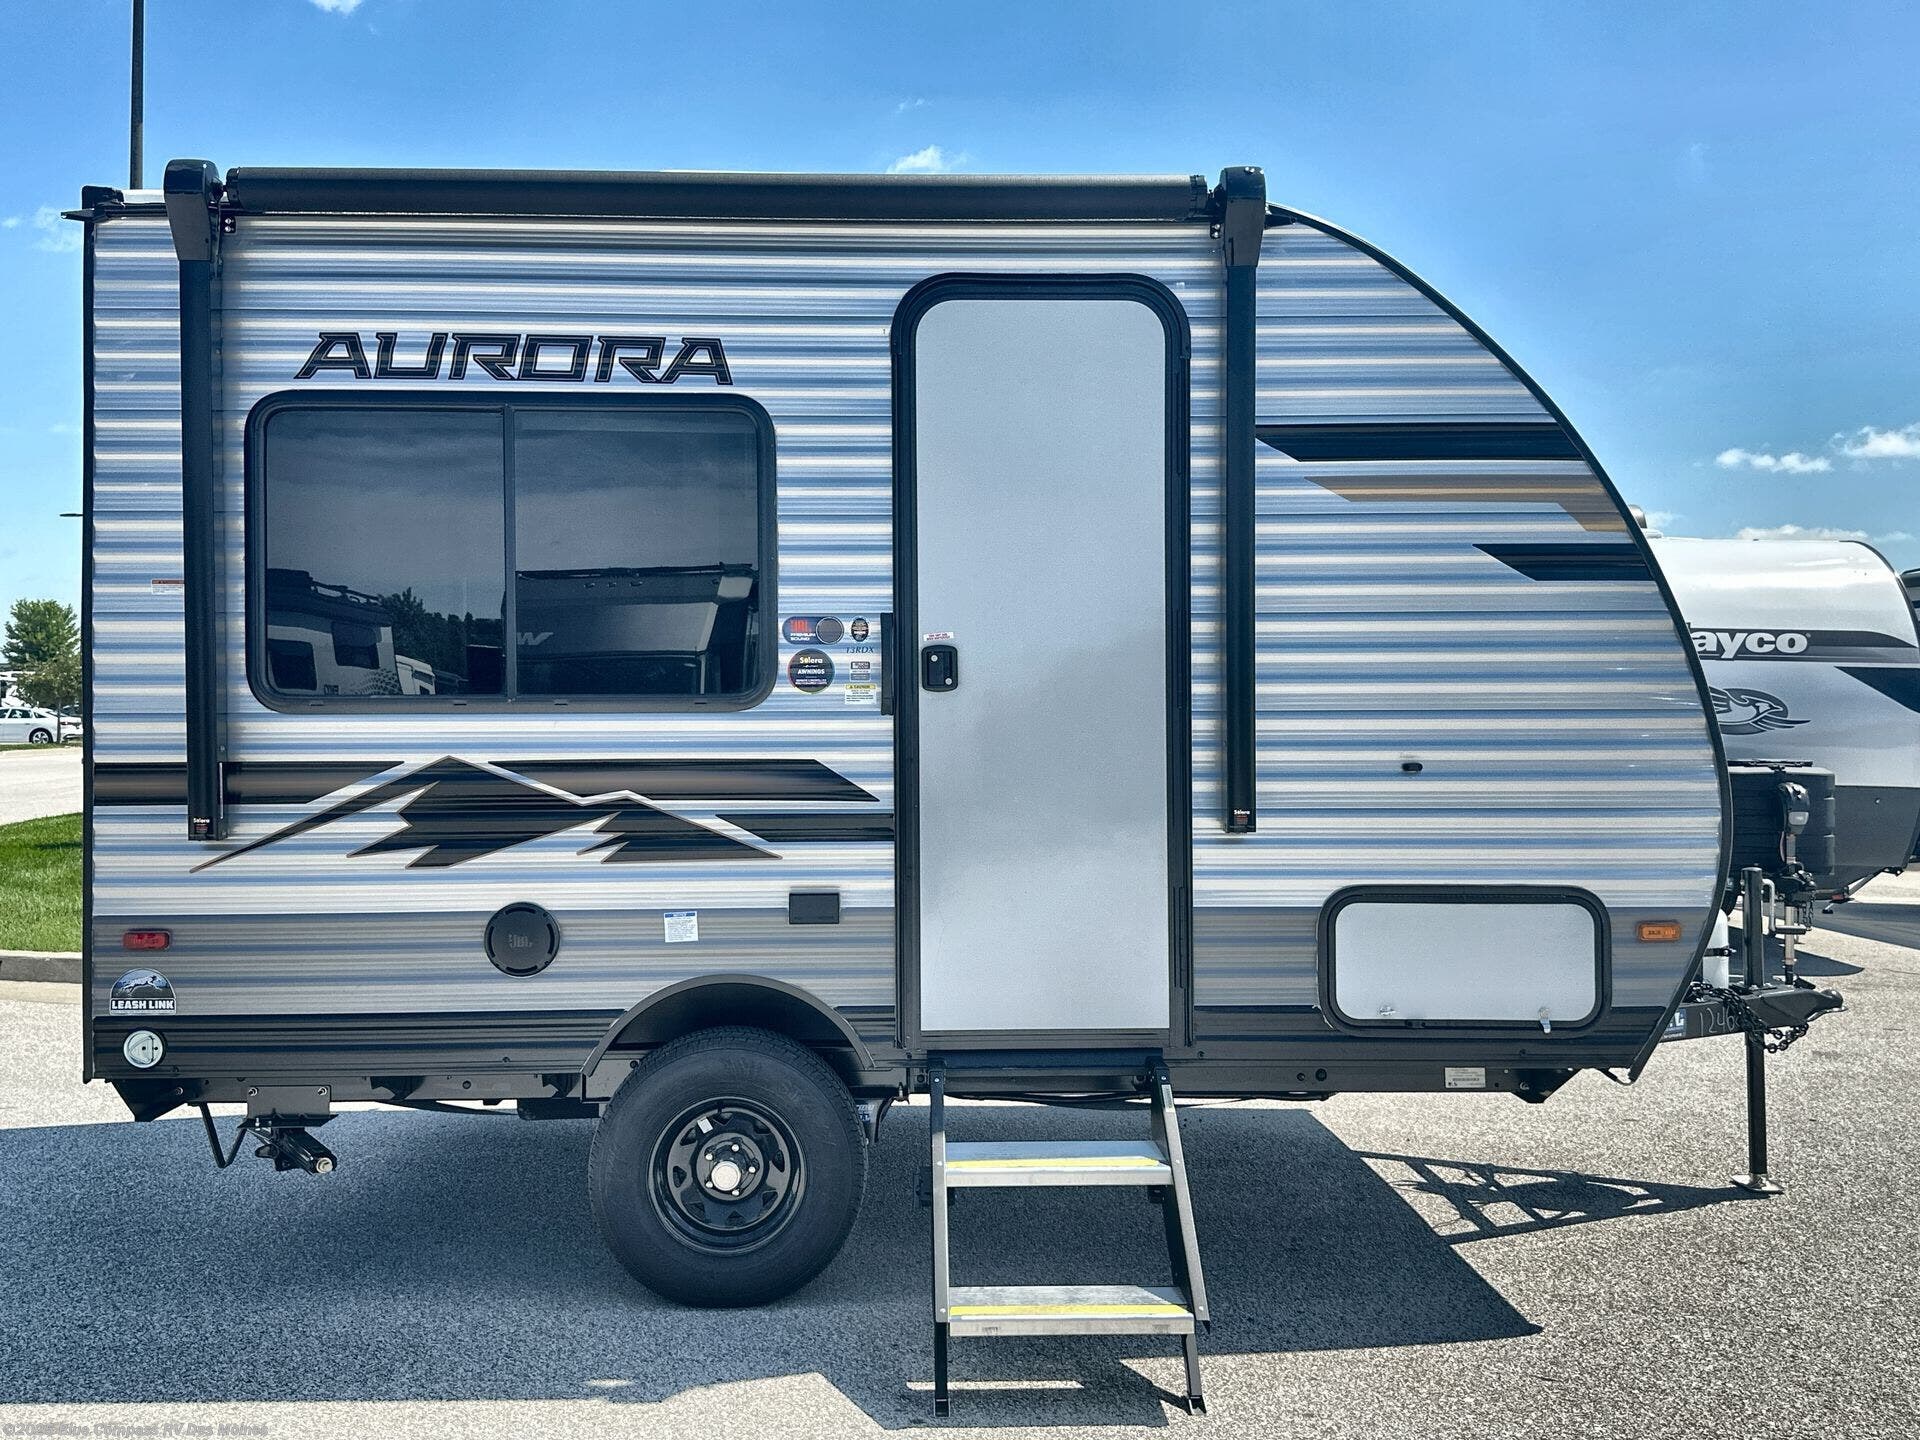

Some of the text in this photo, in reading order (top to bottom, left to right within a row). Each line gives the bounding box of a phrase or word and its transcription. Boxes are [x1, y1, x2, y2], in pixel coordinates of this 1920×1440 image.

[294, 332, 733, 385] AURORA
[846, 646, 874, 654] 13RDX
[800, 656, 823, 664] Solera
[111, 1000, 175, 1010] LEASH LINK
